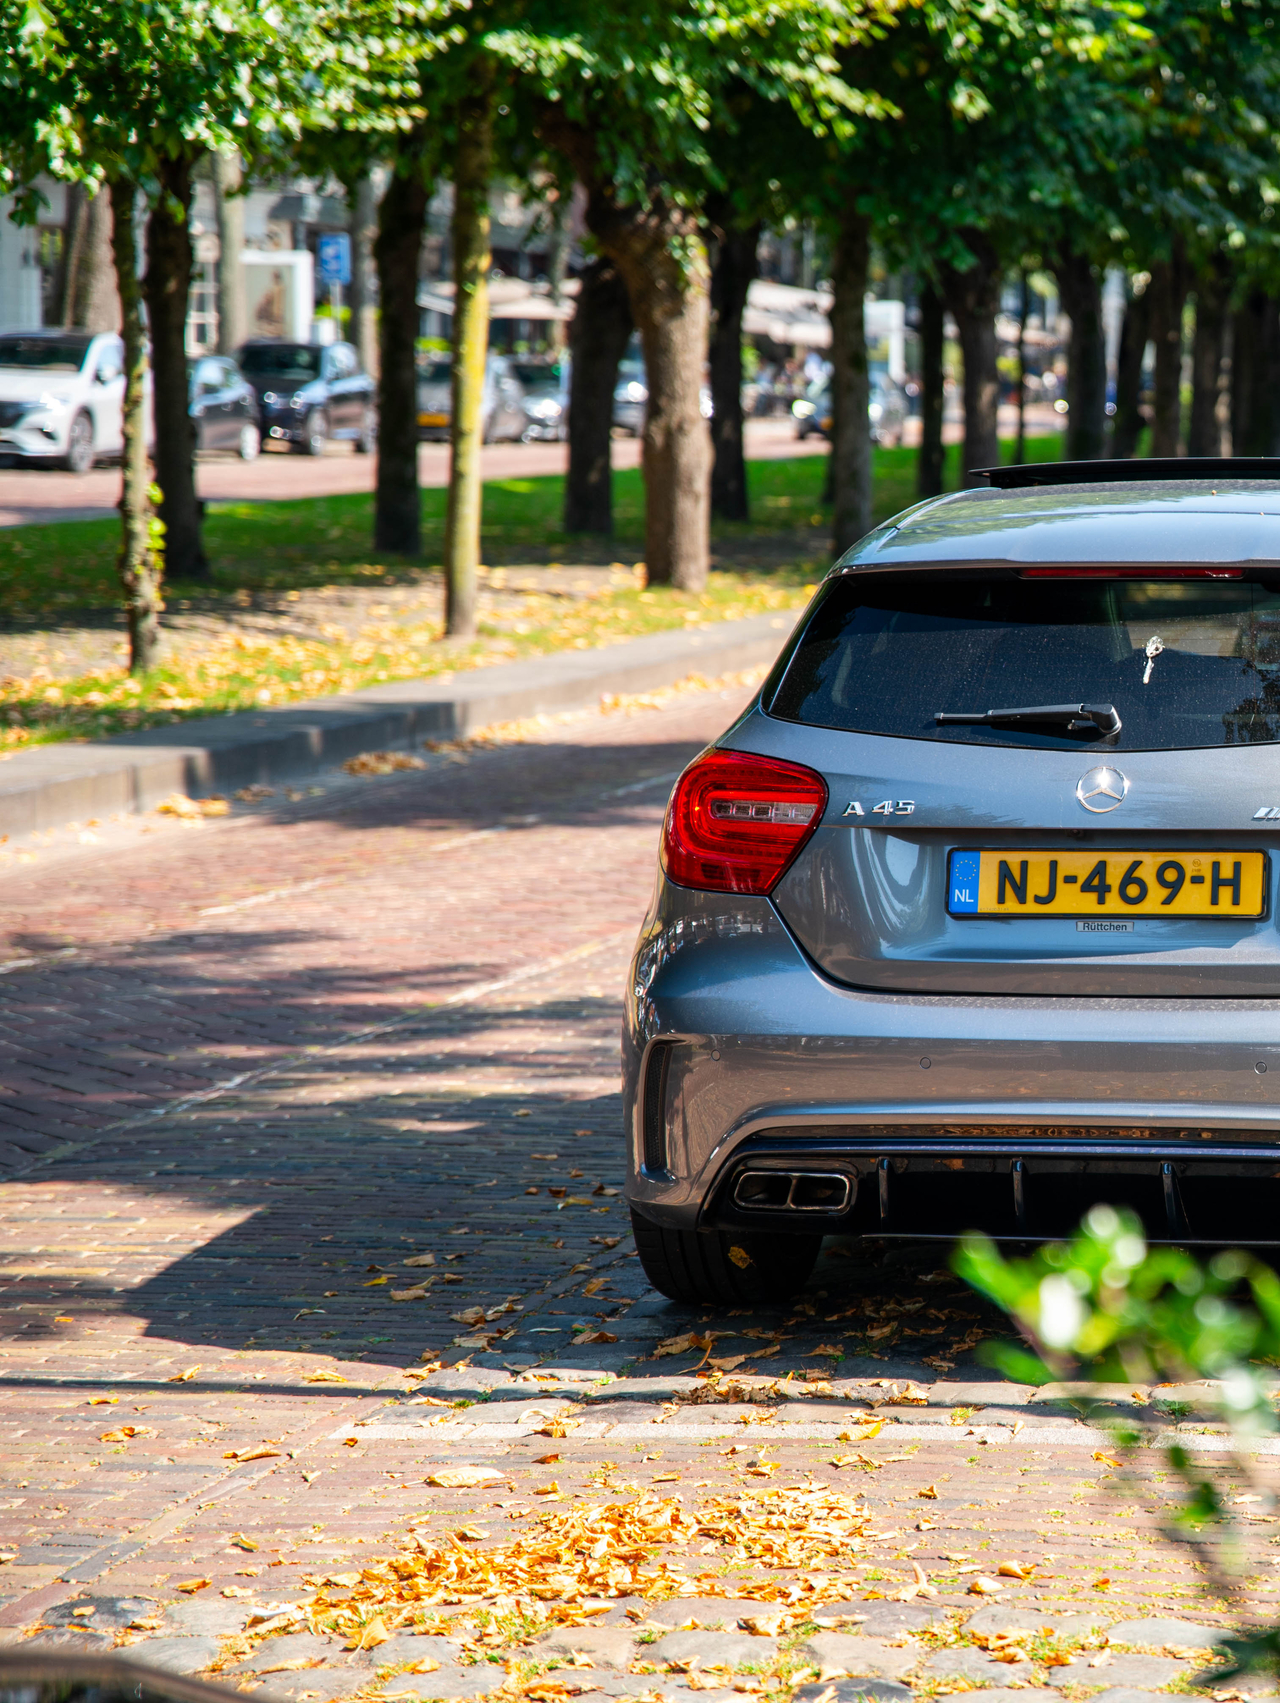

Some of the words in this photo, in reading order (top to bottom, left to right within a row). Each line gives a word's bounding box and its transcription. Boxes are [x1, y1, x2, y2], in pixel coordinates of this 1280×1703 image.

[842, 801, 865, 817] A
[871, 800, 915, 816] 45
[997, 860, 1242, 906] NJ-469-H
[954, 889, 975, 903] NL
[1082, 922, 1128, 932] Rüttchen
